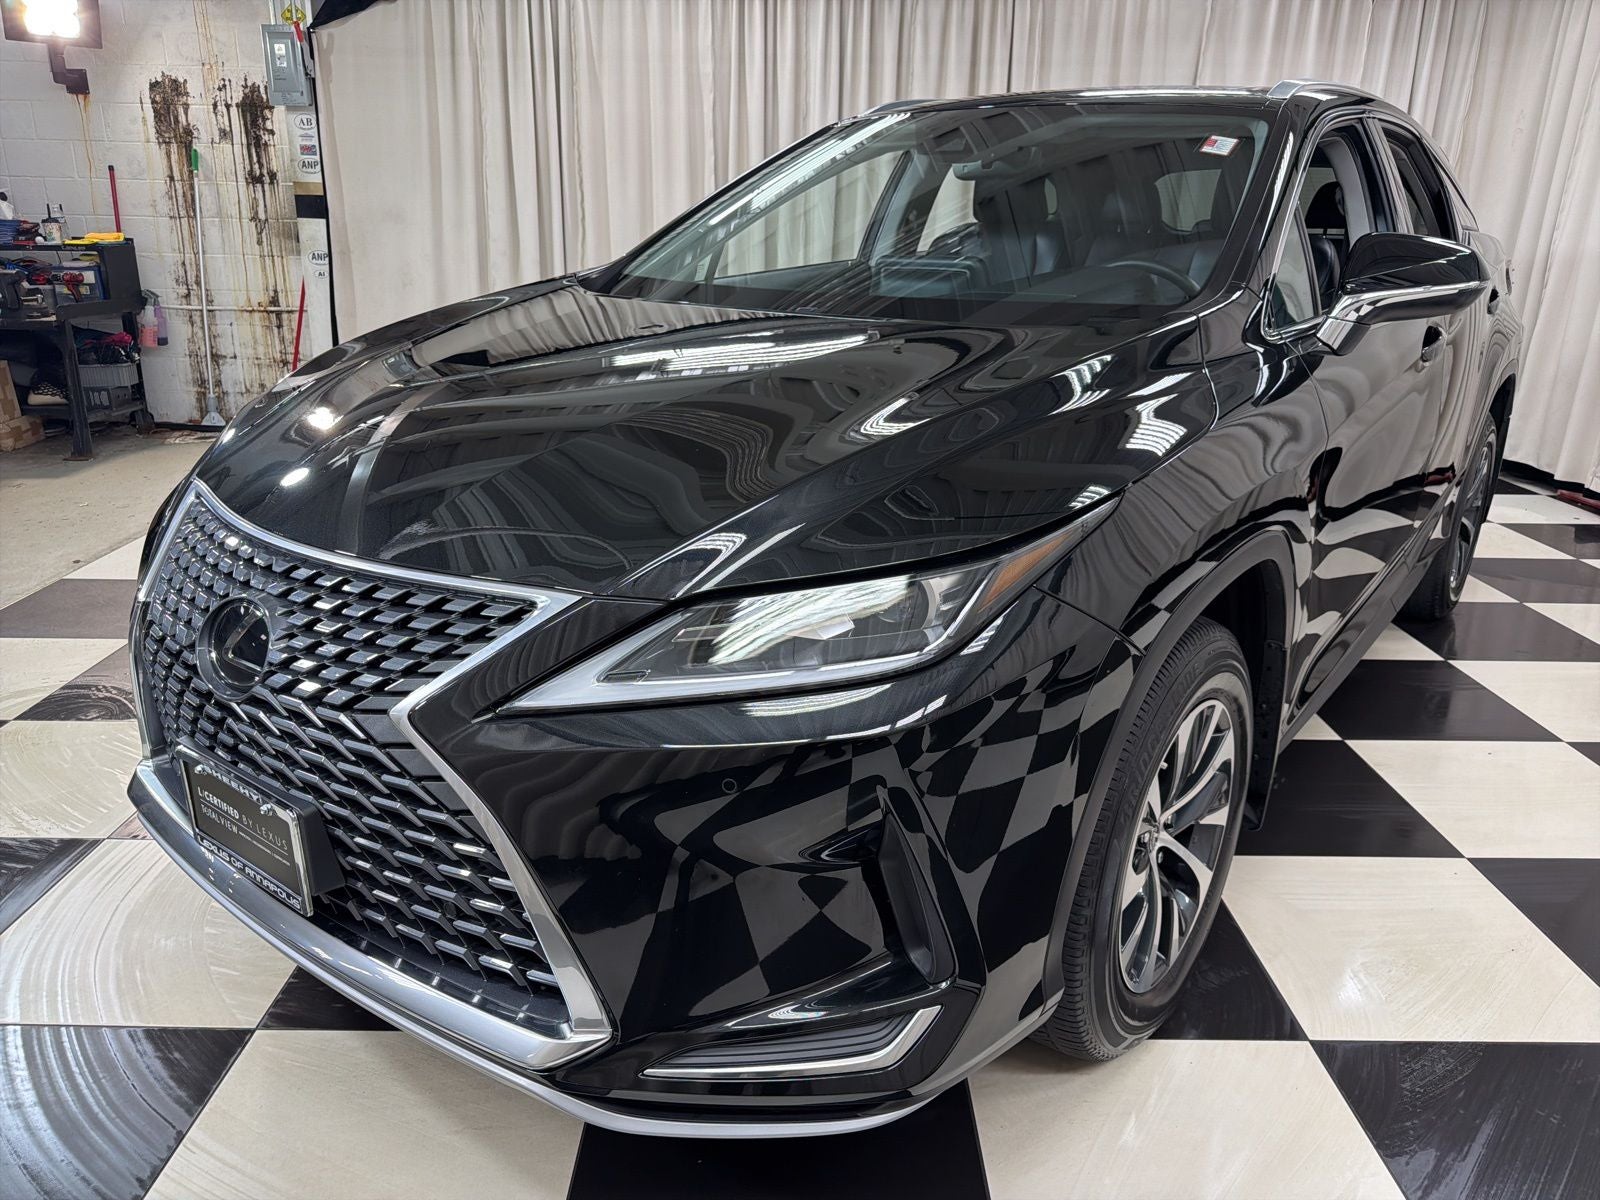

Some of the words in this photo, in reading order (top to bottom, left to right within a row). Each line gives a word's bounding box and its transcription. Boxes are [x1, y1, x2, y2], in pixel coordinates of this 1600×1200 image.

[299, 117, 313, 126] AB
[301, 160, 319, 169] ANP
[311, 252, 329, 261] ANP
[242, 814, 253, 828] BY
[256, 823, 288, 850] LEXUS
[197, 835, 230, 862] LEXUS
[230, 857, 244, 871] OF
[244, 866, 301, 910] ANNAPOLIS
